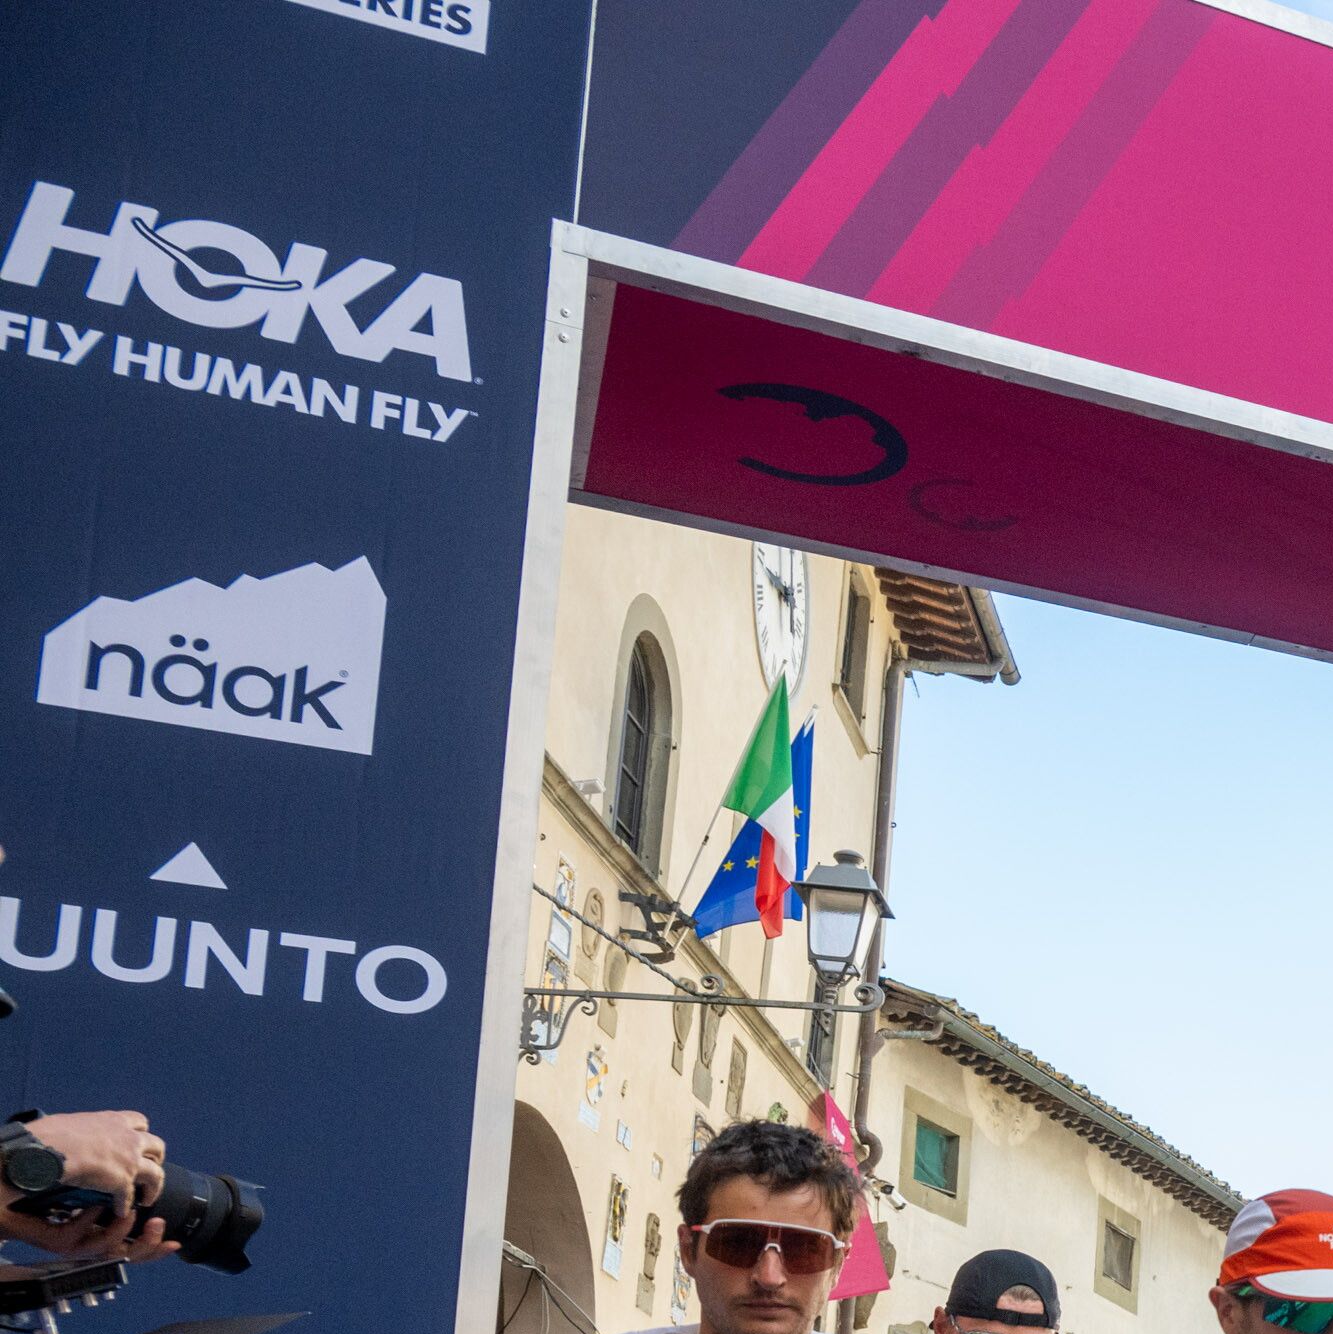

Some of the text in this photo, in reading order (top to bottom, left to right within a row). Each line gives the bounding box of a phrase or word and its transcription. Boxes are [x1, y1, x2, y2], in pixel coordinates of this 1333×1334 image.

[337, 0, 473, 36] RIES
[0, 180, 474, 383] HOKA
[0, 309, 472, 443] FLY HUMAN FLY
[84, 633, 349, 731] näak
